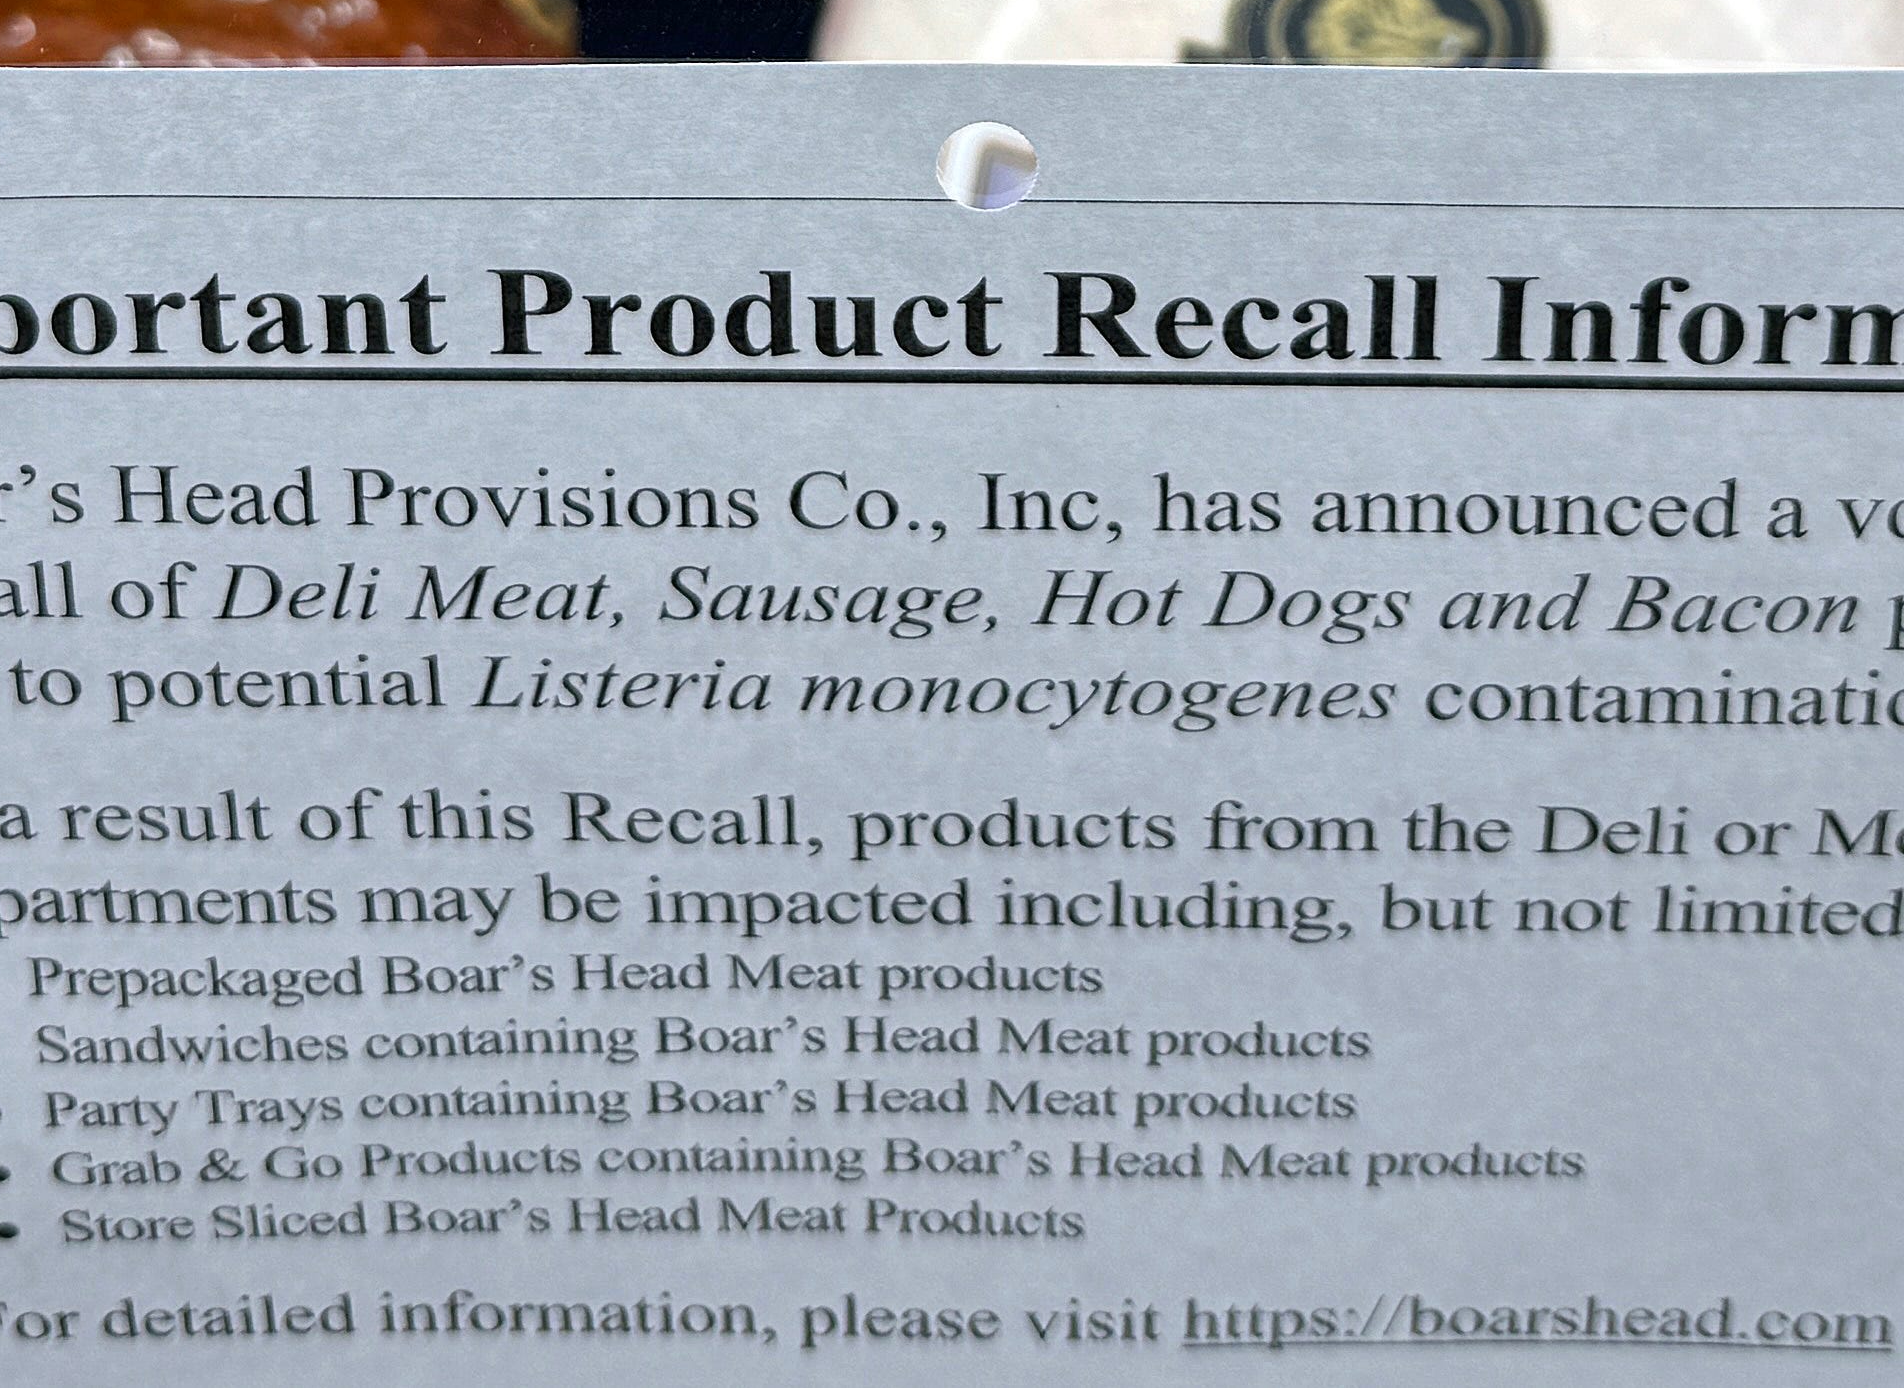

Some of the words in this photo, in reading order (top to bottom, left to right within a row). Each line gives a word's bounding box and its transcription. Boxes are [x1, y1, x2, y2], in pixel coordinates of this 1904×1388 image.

[489, 269, 1003, 359] Product
[1043, 272, 1442, 362] Recall
[109, 465, 320, 529] Head
[343, 467, 759, 530] Provisions
[789, 470, 947, 543] Co.,
[977, 473, 1122, 544] Inc,
[1152, 472, 1282, 536] has
[1311, 477, 1740, 540] announced
[1767, 498, 1808, 541] a
[109, 561, 197, 622] of
[212, 562, 380, 622] Deli
[405, 565, 623, 628] Meat,
[658, 566, 998, 639] Sausage,
[1030, 570, 1184, 628] Hot
[1201, 571, 1411, 644] Dogs
[1439, 573, 1591, 633] and
[1606, 576, 1860, 636] Bacon
[7, 659, 82, 706] to
[107, 654, 447, 725] potential
[470, 656, 771, 713] Listeria
[800, 671, 1397, 732] monocytogenes
[59, 789, 273, 843] result
[297, 787, 383, 842] of
[398, 787, 534, 842] this
[560, 792, 823, 857] Recall,
[848, 797, 1176, 865] products
[1203, 800, 1379, 855] from
[1402, 802, 1512, 857] the
[1535, 806, 1689, 859] Deli
[1714, 822, 1793, 859] or
[357, 887, 515, 938] may
[534, 872, 621, 926] be
[645, 875, 973, 941] impacted
[997, 878, 1353, 945] including,
[1380, 882, 1494, 935] but
[1515, 892, 1632, 935] not
[26, 956, 364, 1010] Prepackaged
[380, 954, 555, 997] Boar's
[570, 953, 710, 993] Head
[727, 954, 862, 991] Meat
[878, 955, 1103, 1003] products
[35, 1024, 348, 1066] Sandwiches
[365, 1017, 639, 1066] containing
[655, 1016, 826, 1056] Boar's
[844, 1016, 980, 1055] Head
[998, 1018, 1131, 1057] Meat
[1146, 1021, 1372, 1070] products
[45, 1092, 178, 1138] Party
[194, 1090, 343, 1134] Trays
[360, 1080, 631, 1128] containing
[647, 1079, 816, 1116] Boar's
[834, 1078, 968, 1116] Head
[986, 1080, 1117, 1119] Meat
[1134, 1082, 1357, 1130] products
[51, 1150, 181, 1189] Grab
[198, 1148, 248, 1185] &
[264, 1146, 342, 1181] Go
[361, 1141, 581, 1179] Products
[597, 1137, 866, 1185] containing
[883, 1138, 1051, 1178] Boar's
[1070, 1142, 1203, 1180] Head
[1221, 1144, 1350, 1181] Meat
[1366, 1142, 1585, 1189] products
[59, 1210, 194, 1246] Store
[211, 1201, 367, 1241] Sliced
[385, 1198, 550, 1237] Boar's
[569, 1197, 701, 1235] Head
[718, 1197, 846, 1234] Meat
[864, 1198, 1085, 1241] Products
[100, 1292, 356, 1341] detailed
[381, 1289, 777, 1346] information,
[801, 1293, 1001, 1353] please
[1026, 1297, 1158, 1344] visit
[1182, 1295, 1893, 1354] https://boarshead.com
